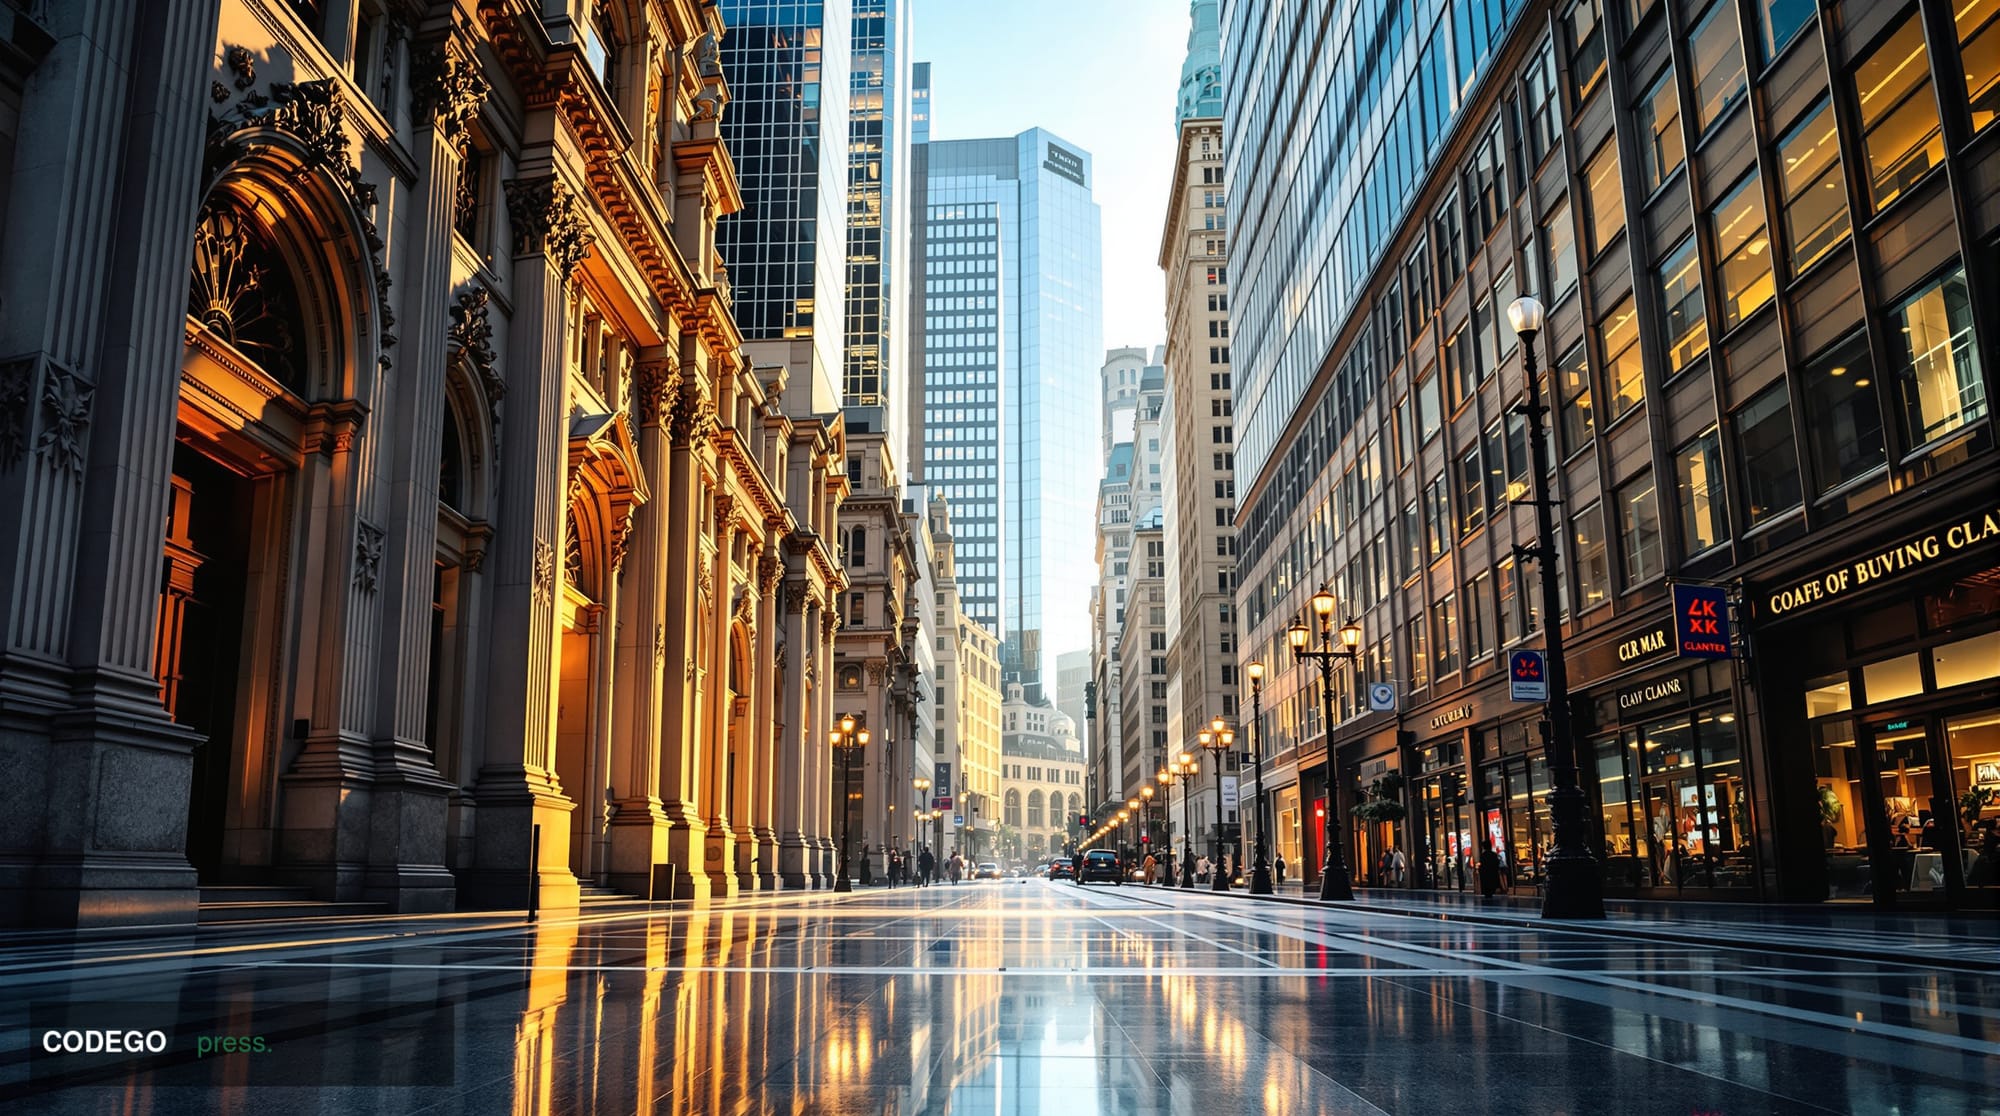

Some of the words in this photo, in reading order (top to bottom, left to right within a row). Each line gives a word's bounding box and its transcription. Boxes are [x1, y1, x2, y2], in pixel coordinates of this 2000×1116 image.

[1770, 580, 1824, 615] COAFE
[1825, 568, 1849, 594] OF
[1854, 535, 1940, 585] BUVING
[1946, 508, 2000, 549] CLA
[1690, 618, 1720, 635] XK
[1639, 630, 1667, 655] MAR
